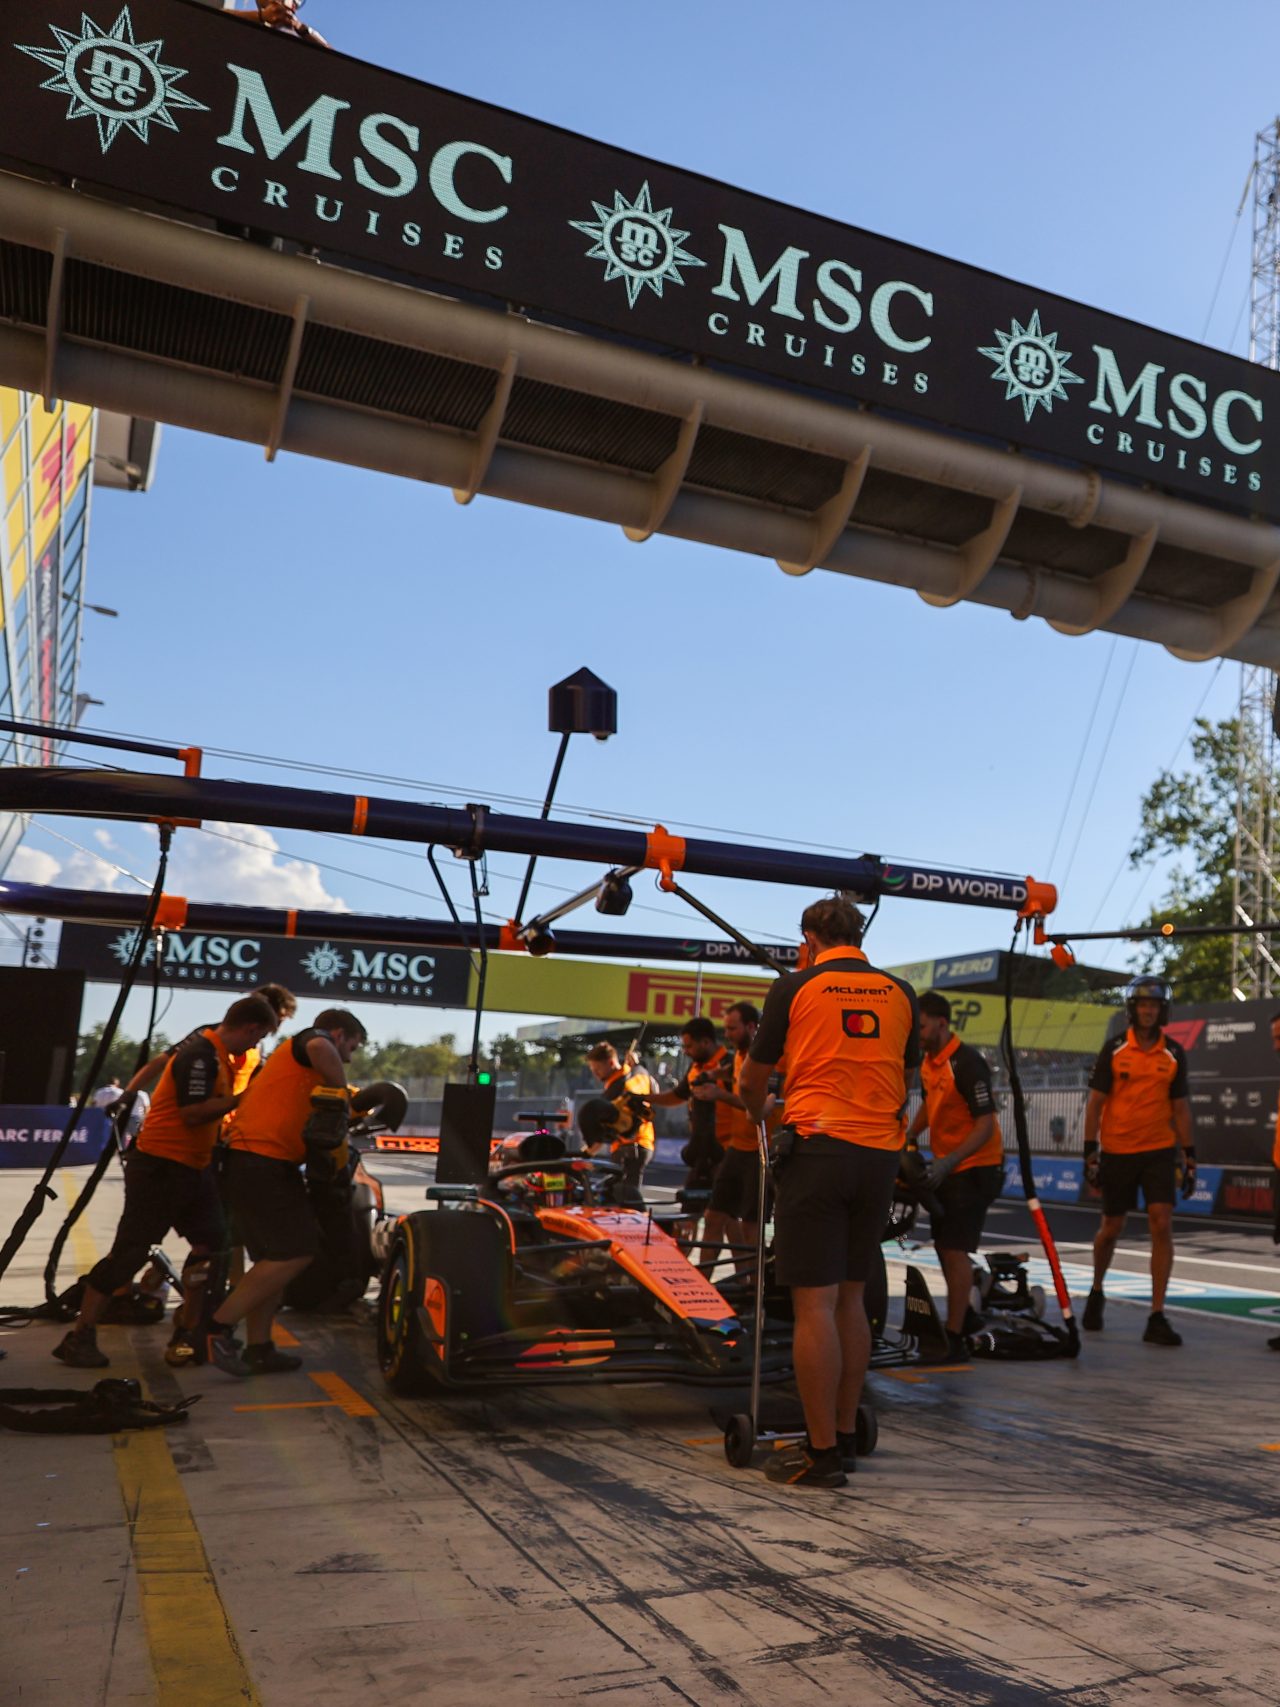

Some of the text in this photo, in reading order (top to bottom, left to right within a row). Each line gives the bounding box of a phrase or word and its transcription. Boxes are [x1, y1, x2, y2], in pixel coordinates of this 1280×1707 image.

[217, 64, 513, 223] MSC
[212, 167, 503, 270] CRUISES
[712, 224, 933, 352] MSC
[709, 313, 929, 393] CRUISES
[1089, 345, 1263, 454] MSC
[1088, 424, 1261, 491] CRUISES
[912, 873, 1027, 902] DP WORLD
[165, 933, 260, 968] MSC
[349, 949, 436, 983] MSC
[706, 943, 799, 961] DP WRLD
[949, 956, 994, 976] ZERO
[163, 966, 258, 982] CRUISES
[347, 981, 433, 996] CRUISES
[821, 986, 887, 996] McLaren
